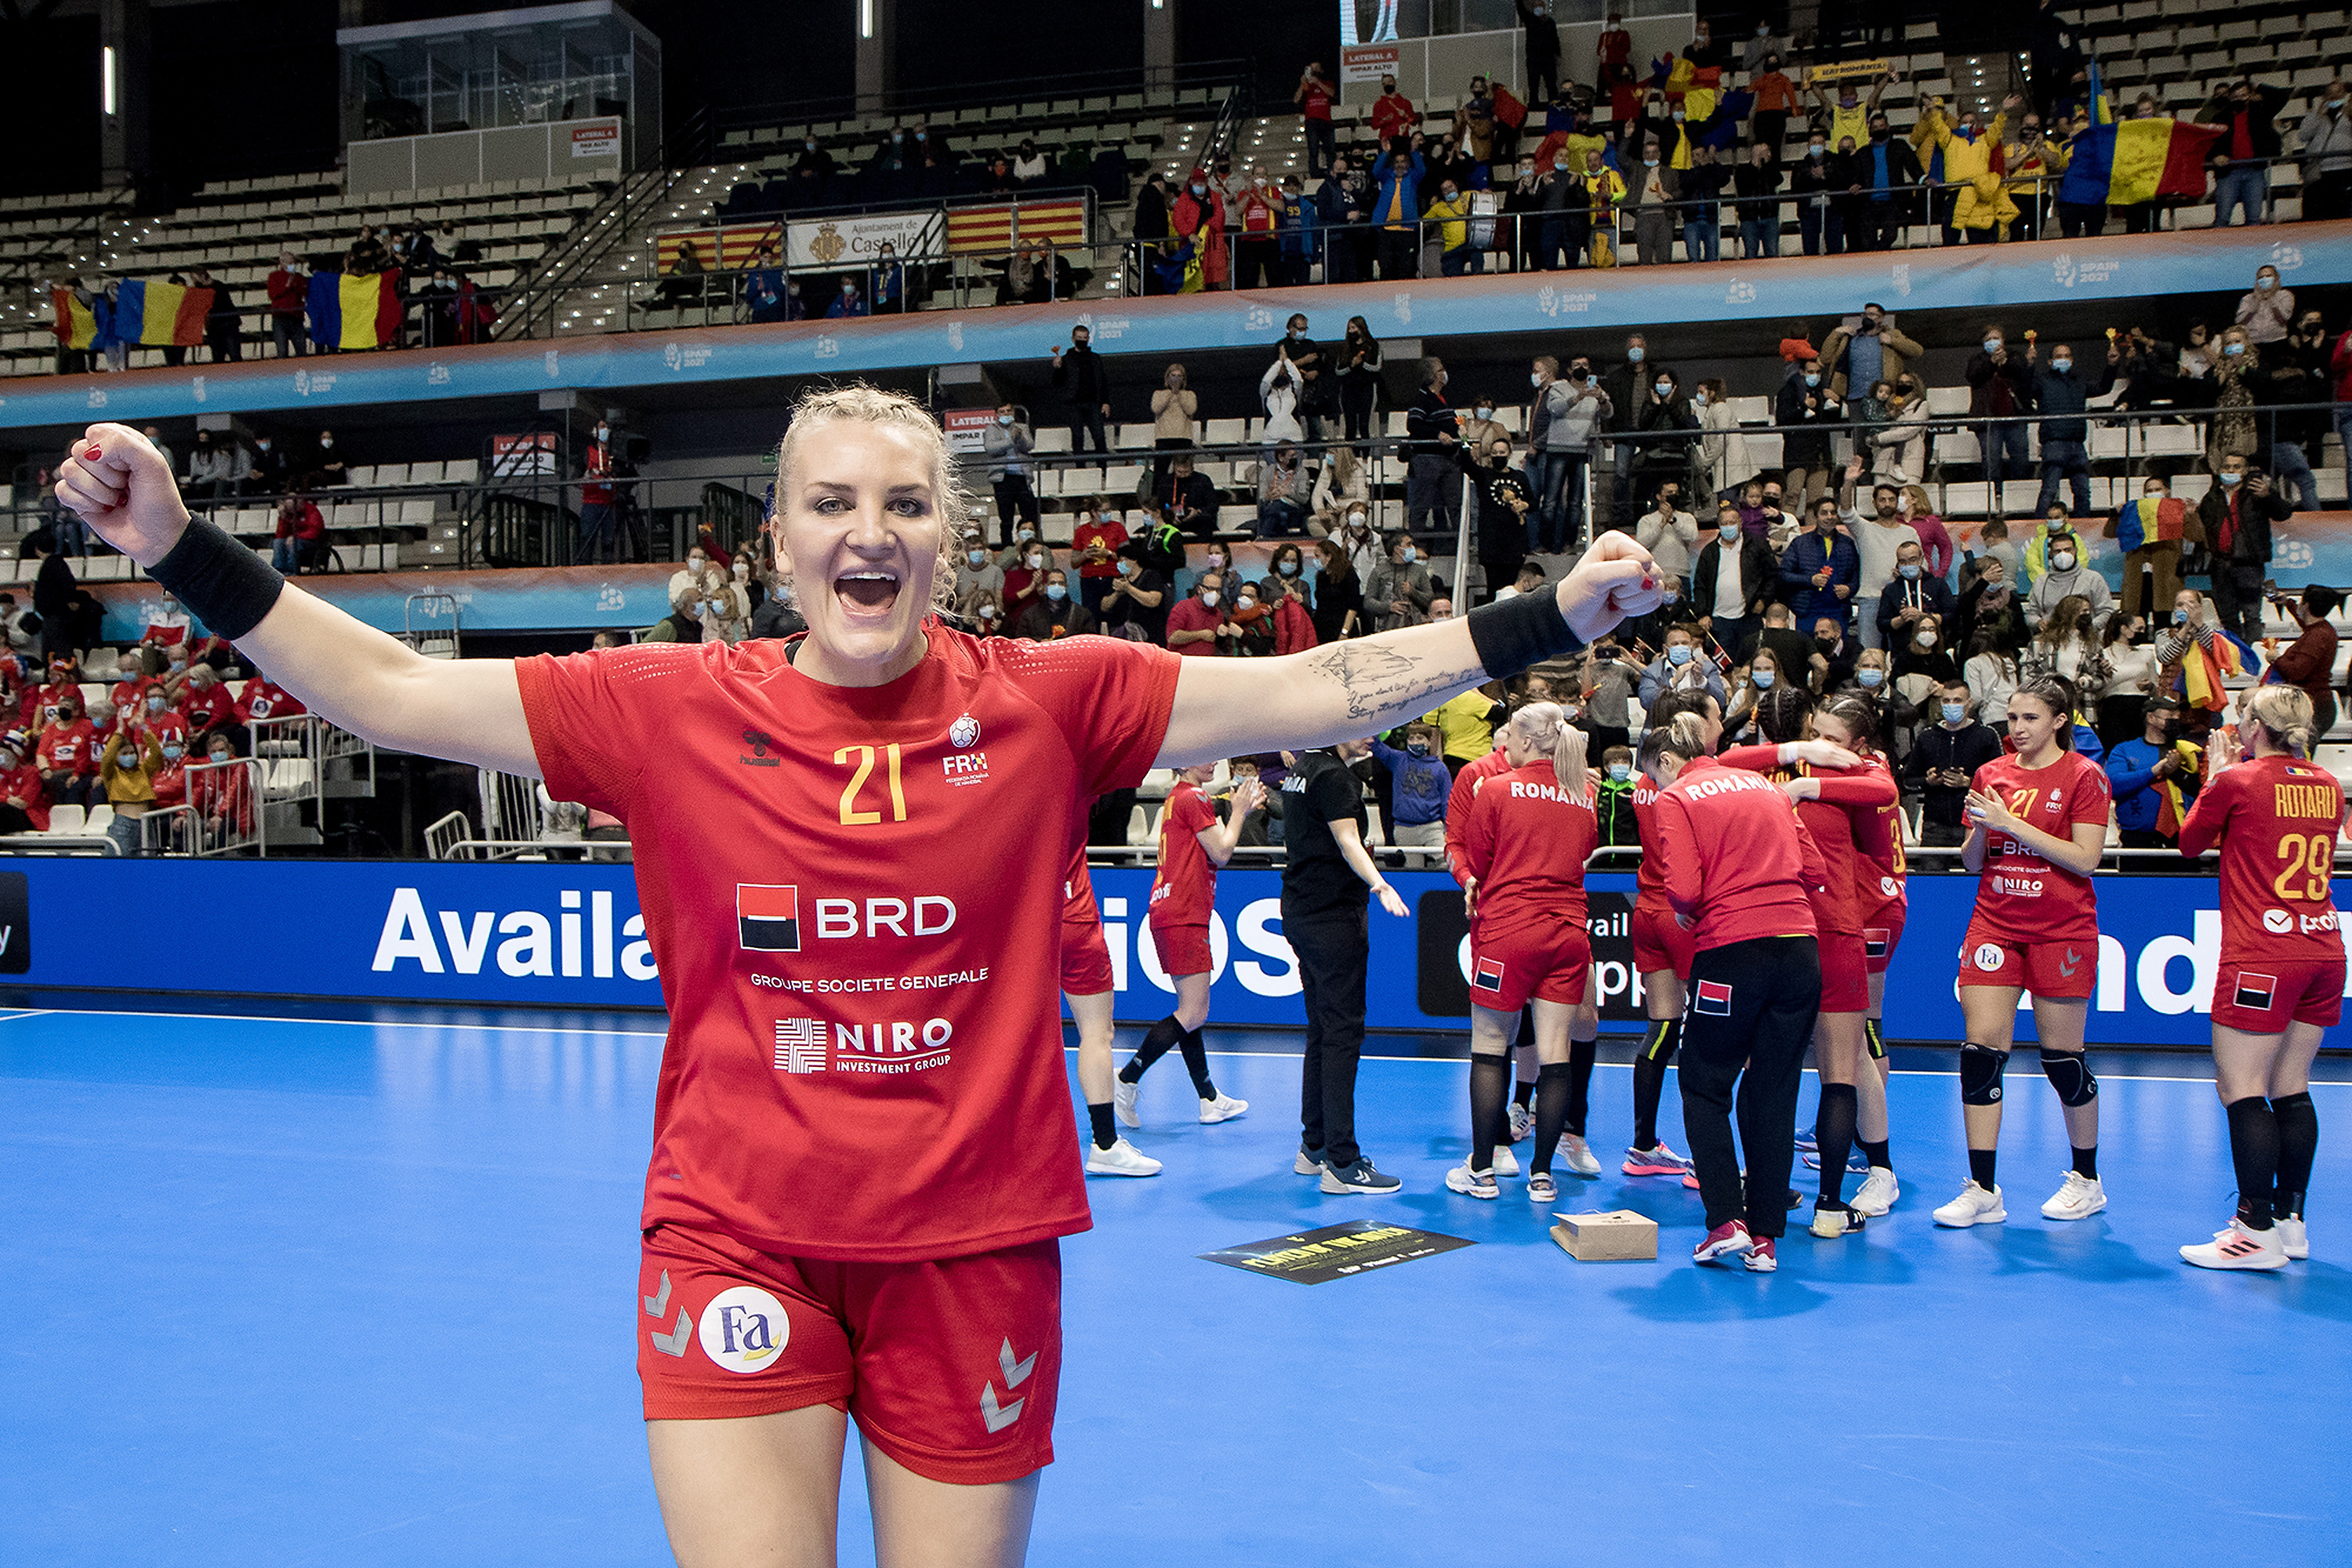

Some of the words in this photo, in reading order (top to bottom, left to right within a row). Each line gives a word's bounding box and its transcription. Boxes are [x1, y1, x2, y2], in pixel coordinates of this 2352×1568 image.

[1349, 53, 1384, 62] LATERAL
[1287, 205, 1301, 216] 99
[851, 222, 903, 234] Ajuntament
[906, 220, 917, 230] de
[2080, 260, 2119, 271] SPAIN
[2080, 271, 2109, 283] 2021
[1562, 292, 1597, 303] SPAIN
[1562, 303, 1588, 313] 2021
[951, 416, 996, 426] LATERAL
[832, 742, 908, 826] 21
[1685, 774, 1780, 802] ROMÂNIA
[2009, 789, 2039, 818] 21
[2274, 783, 2337, 819] ROTARU
[2274, 833, 2332, 902] 29
[2004, 877, 2044, 891] NIRO
[815, 895, 958, 939] BRD
[1981, 948, 1998, 965] Fa
[750, 973, 813, 993] GROUPE
[817, 978, 895, 993] SOCIETE
[899, 967, 989, 991] GENERALE
[835, 1018, 953, 1053] NIRO
[836, 1061, 911, 1074] INVESTMENT
[914, 1054, 951, 1071] GROUP
[717, 1303, 775, 1355] Fa
